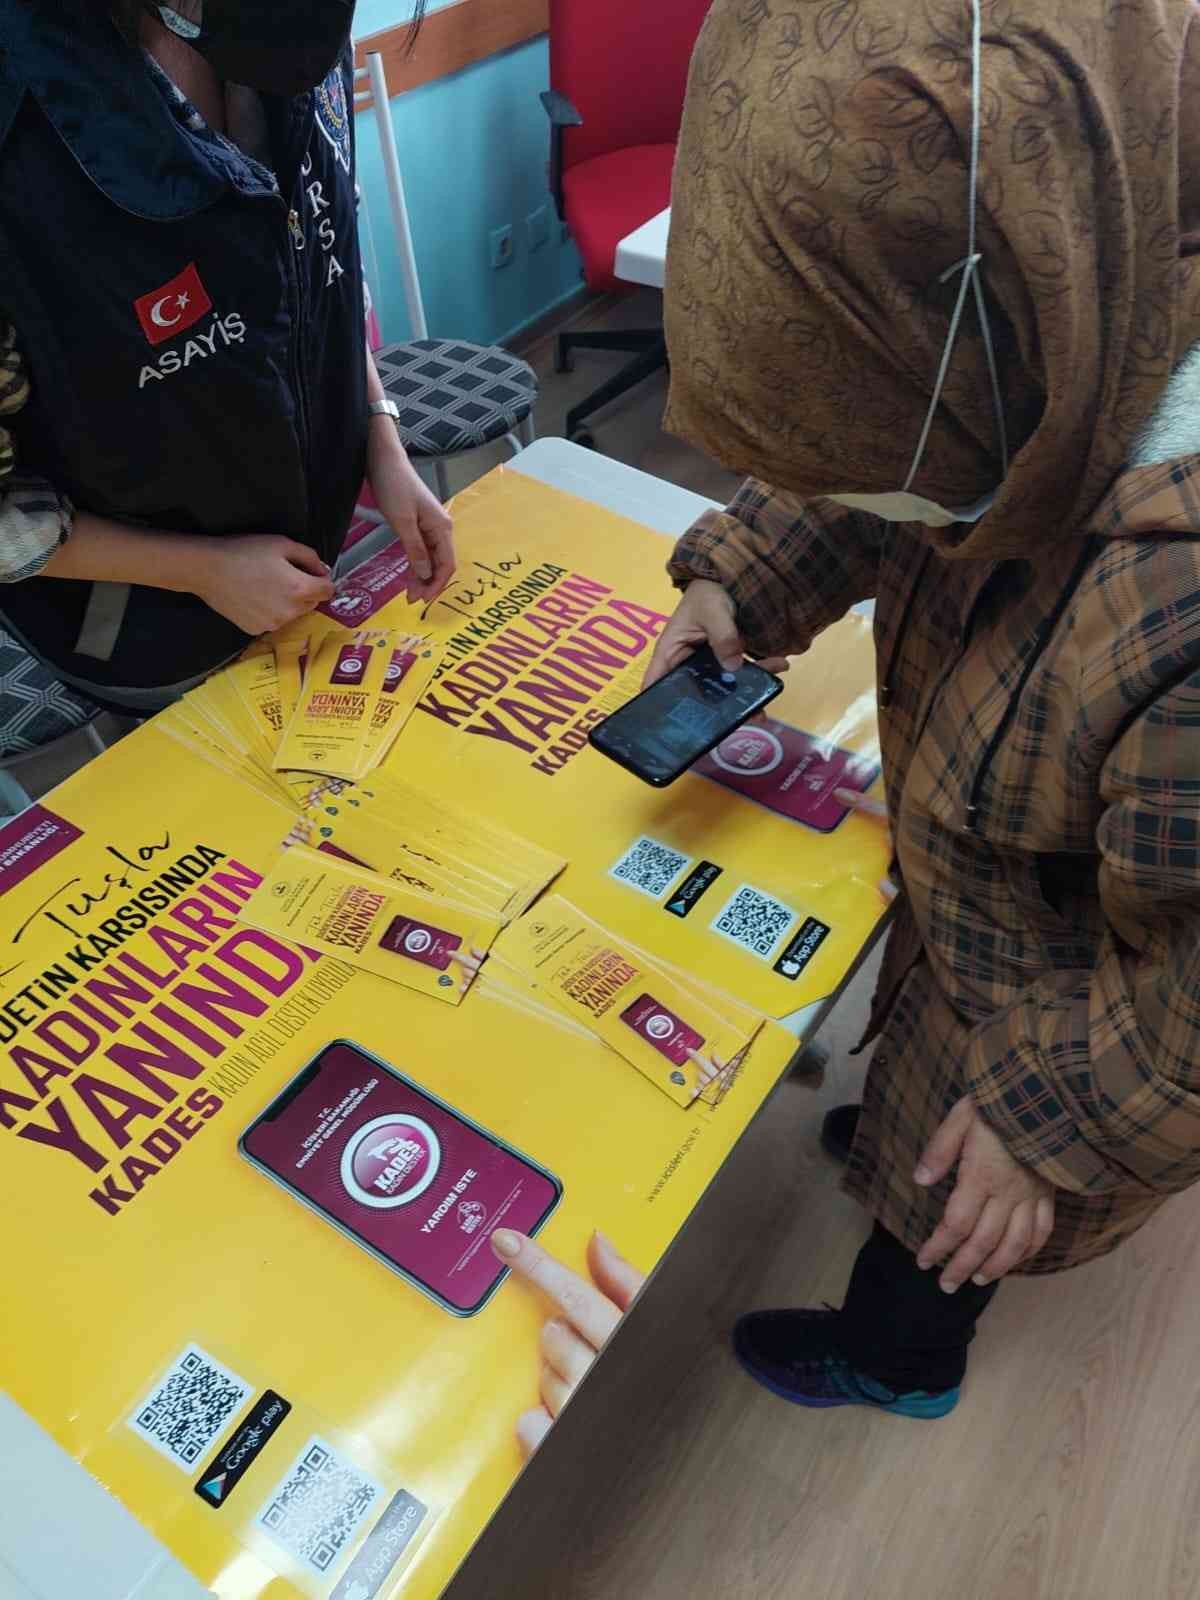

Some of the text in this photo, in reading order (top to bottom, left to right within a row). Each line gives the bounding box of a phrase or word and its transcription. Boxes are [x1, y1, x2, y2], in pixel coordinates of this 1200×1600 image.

[139, 312, 247, 389] ASAYİŞ
[415, 573, 614, 728] KADINLARIN
[463, 599, 672, 754] YANINDA
[531, 708, 609, 776] KADES
[325, 886, 371, 945] KADINLARIN
[335, 893, 386, 949] YANINDA
[567, 953, 625, 1001] KADINLARIN
[578, 962, 641, 1011] YANINDA
[16, 928, 323, 1174] YANIND
[88, 1086, 224, 1216] KADES
[374, 1141, 421, 1191] KADES
[420, 1168, 478, 1234] YARDIM İSTE
[226, 1425, 264, 1470] Google
[261, 1400, 284, 1427] play
[386, 1504, 418, 1547] Store
